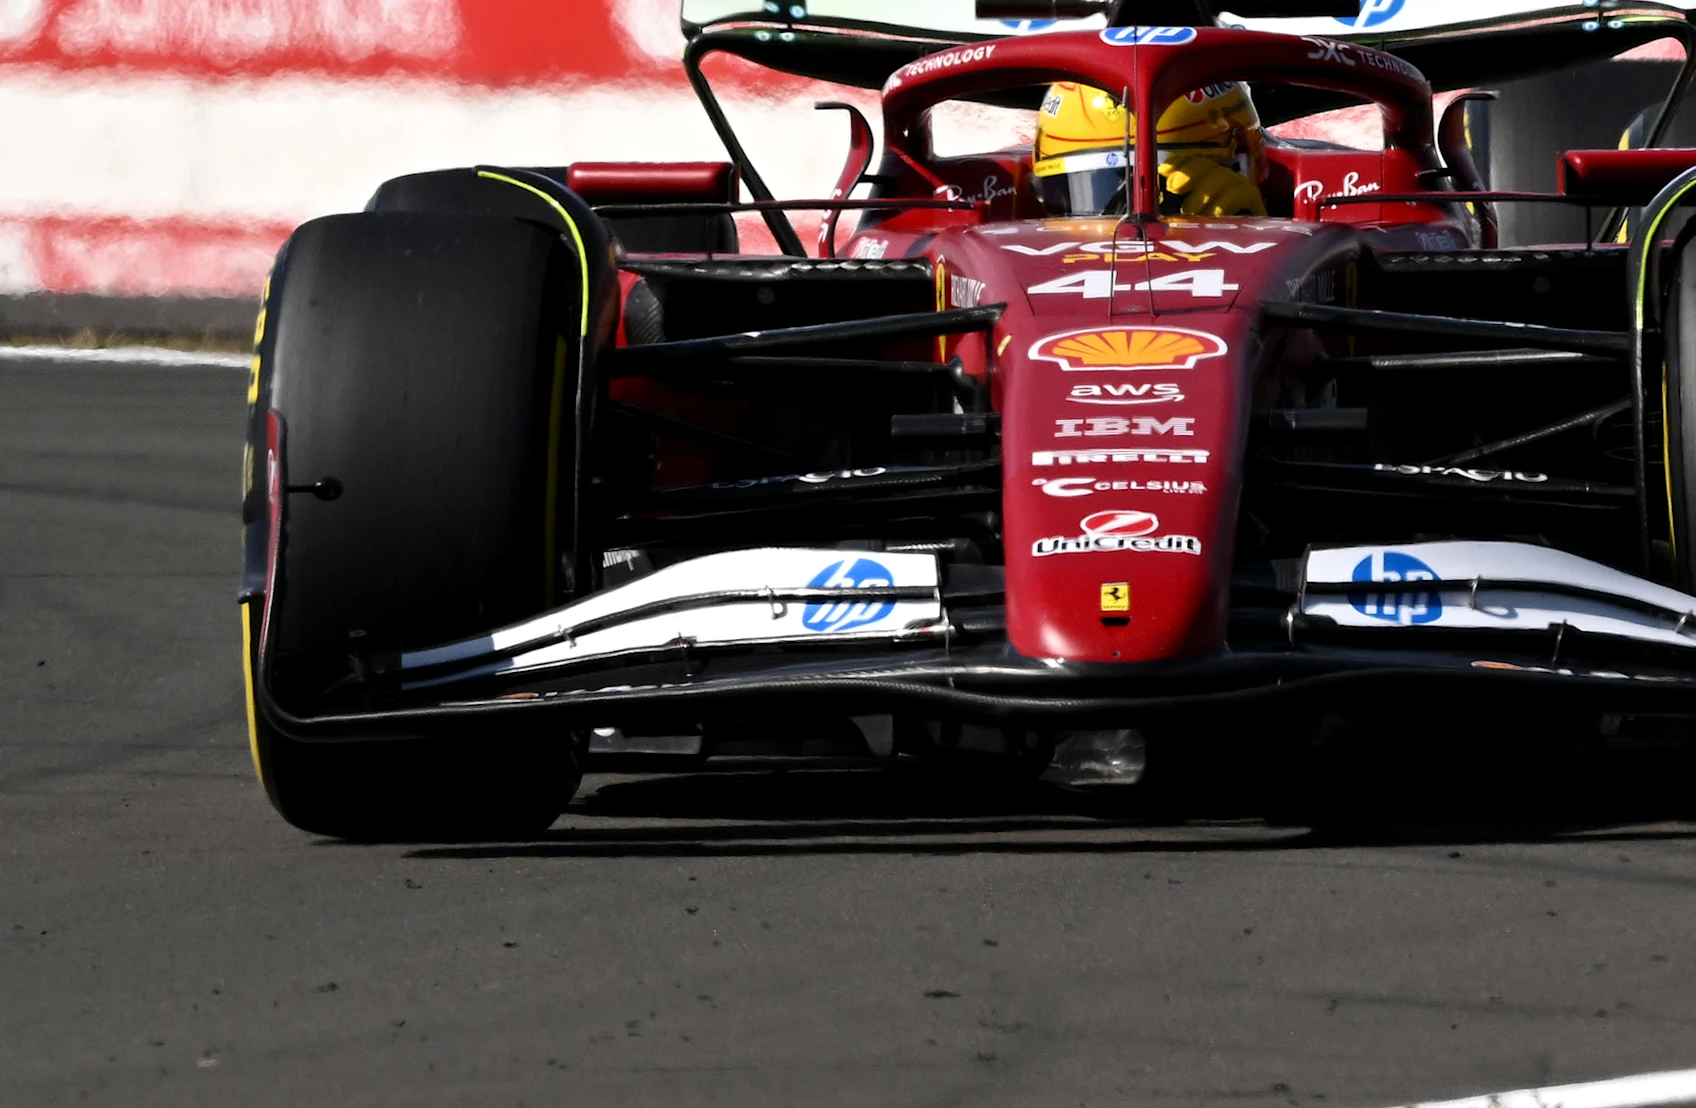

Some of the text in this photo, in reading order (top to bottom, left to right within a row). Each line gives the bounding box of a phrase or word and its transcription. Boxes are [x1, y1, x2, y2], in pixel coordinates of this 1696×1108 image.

[905, 45, 996, 77] TECHNOLOGY
[1001, 240, 1278, 255] VGW
[1061, 253, 1217, 264] PLAY
[1027, 268, 1240, 299] 44
[1070, 383, 1180, 397] aws
[1054, 416, 1196, 438] IBM
[1032, 448, 1211, 466] PIRELLI
[1036, 534, 1199, 554] UniCredit
[806, 559, 894, 632] hp
[1363, 552, 1436, 624] hp
